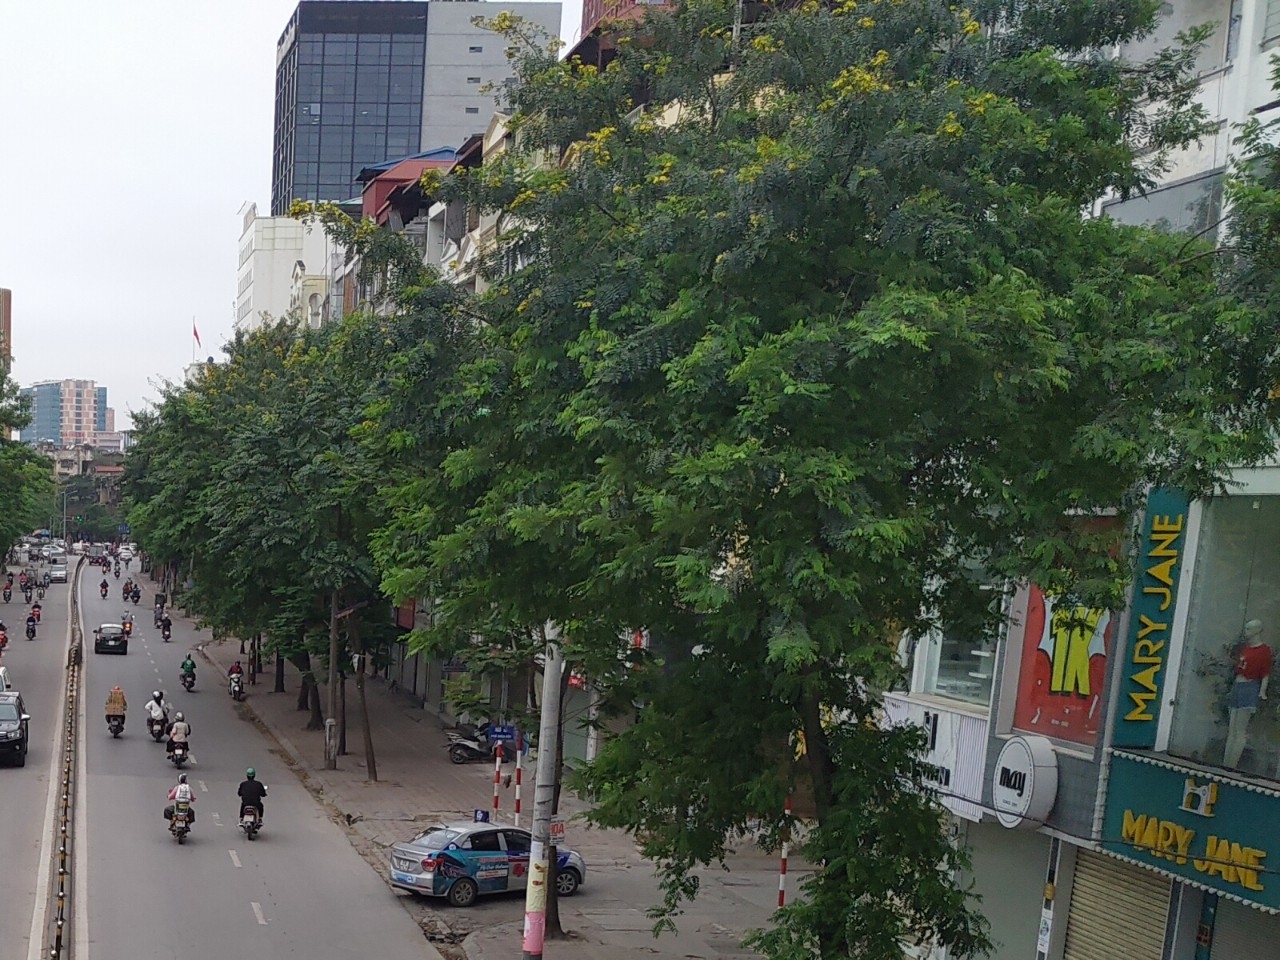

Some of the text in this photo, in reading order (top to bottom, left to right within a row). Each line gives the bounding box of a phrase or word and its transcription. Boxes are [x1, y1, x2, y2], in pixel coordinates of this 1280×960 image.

[1124, 514, 1183, 721] MARY JANE
[1122, 809, 1267, 891] MARY JANE
